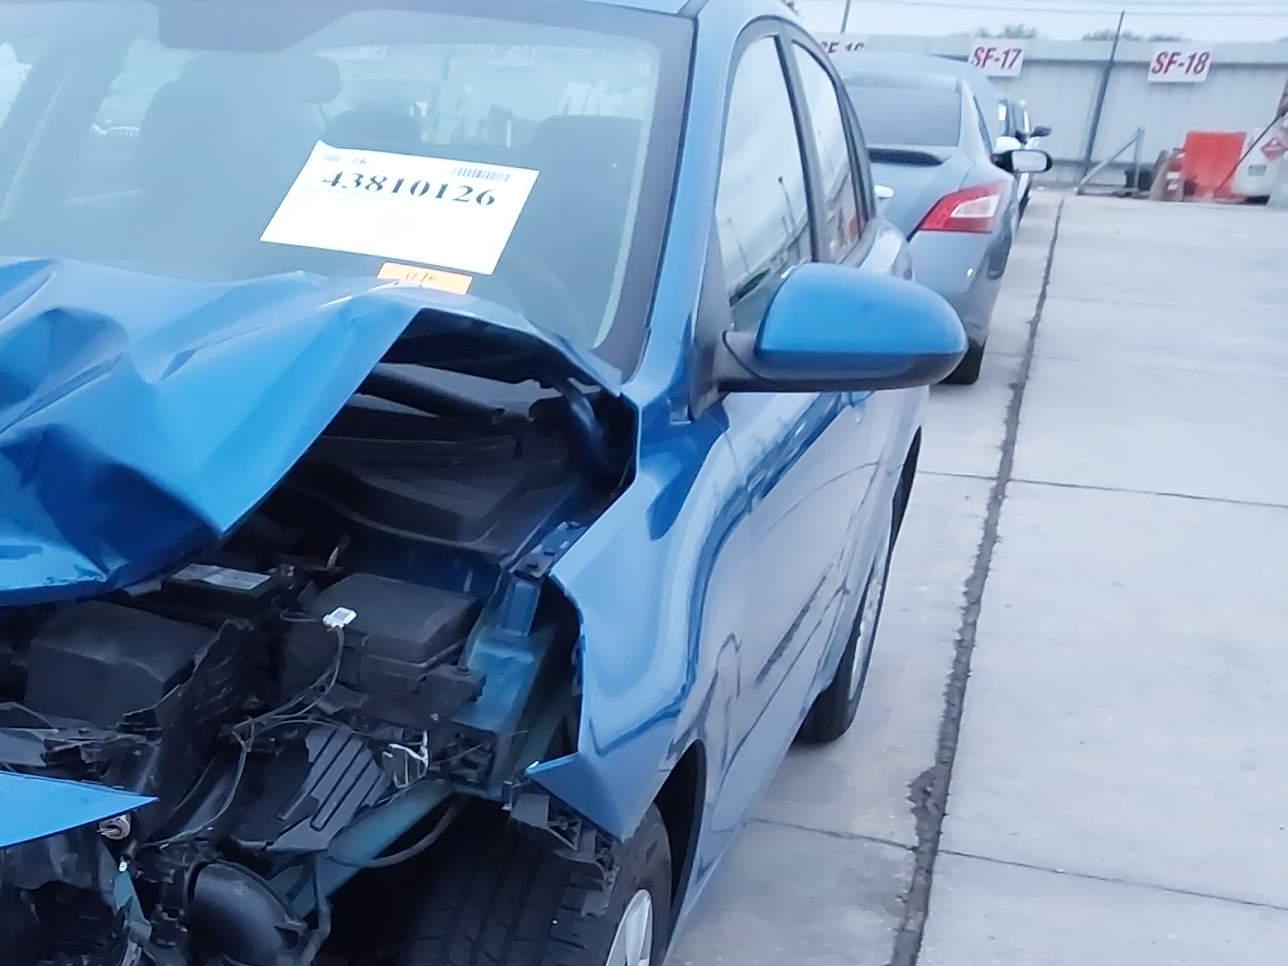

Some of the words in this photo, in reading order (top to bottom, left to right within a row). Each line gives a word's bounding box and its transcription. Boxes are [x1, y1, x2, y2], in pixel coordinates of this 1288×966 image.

[970, 46, 1023, 69] SF-17
[1151, 51, 1210, 74] SF-18
[321, 170, 496, 206] 43810126
